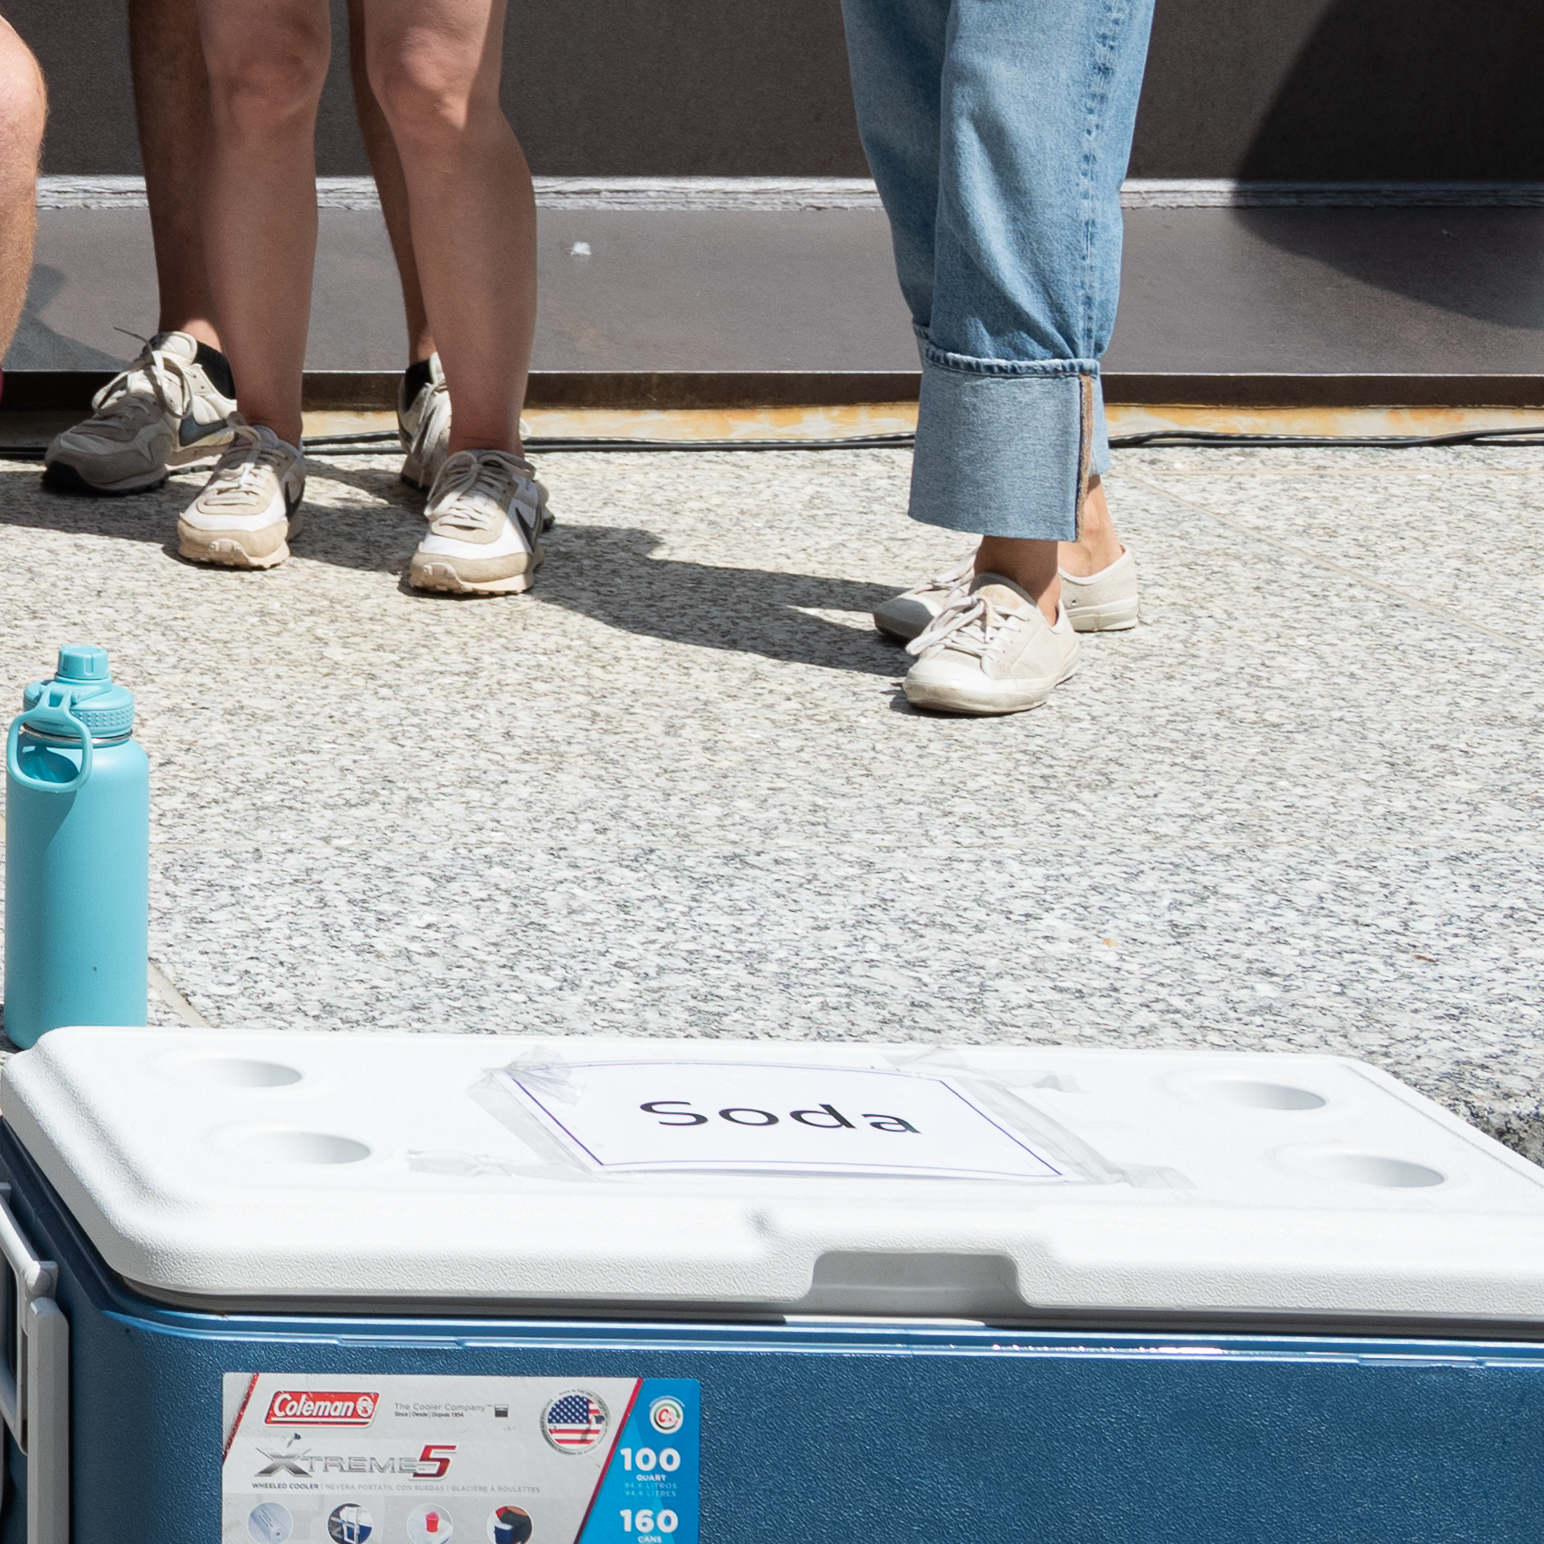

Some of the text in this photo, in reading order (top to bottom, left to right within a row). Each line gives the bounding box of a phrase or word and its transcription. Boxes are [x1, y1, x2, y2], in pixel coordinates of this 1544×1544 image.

[639, 1100, 922, 1135] Soda
[273, 1393, 354, 1418] Coleman
[394, 1403, 410, 1411] The
[413, 1403, 442, 1411] Cooler
[620, 1447, 681, 1472] 100
[636, 1474, 667, 1482] QUART
[496, 1485, 540, 1493] ROULETTES
[619, 1508, 679, 1533] 160
[637, 1535, 662, 1544] CANS
